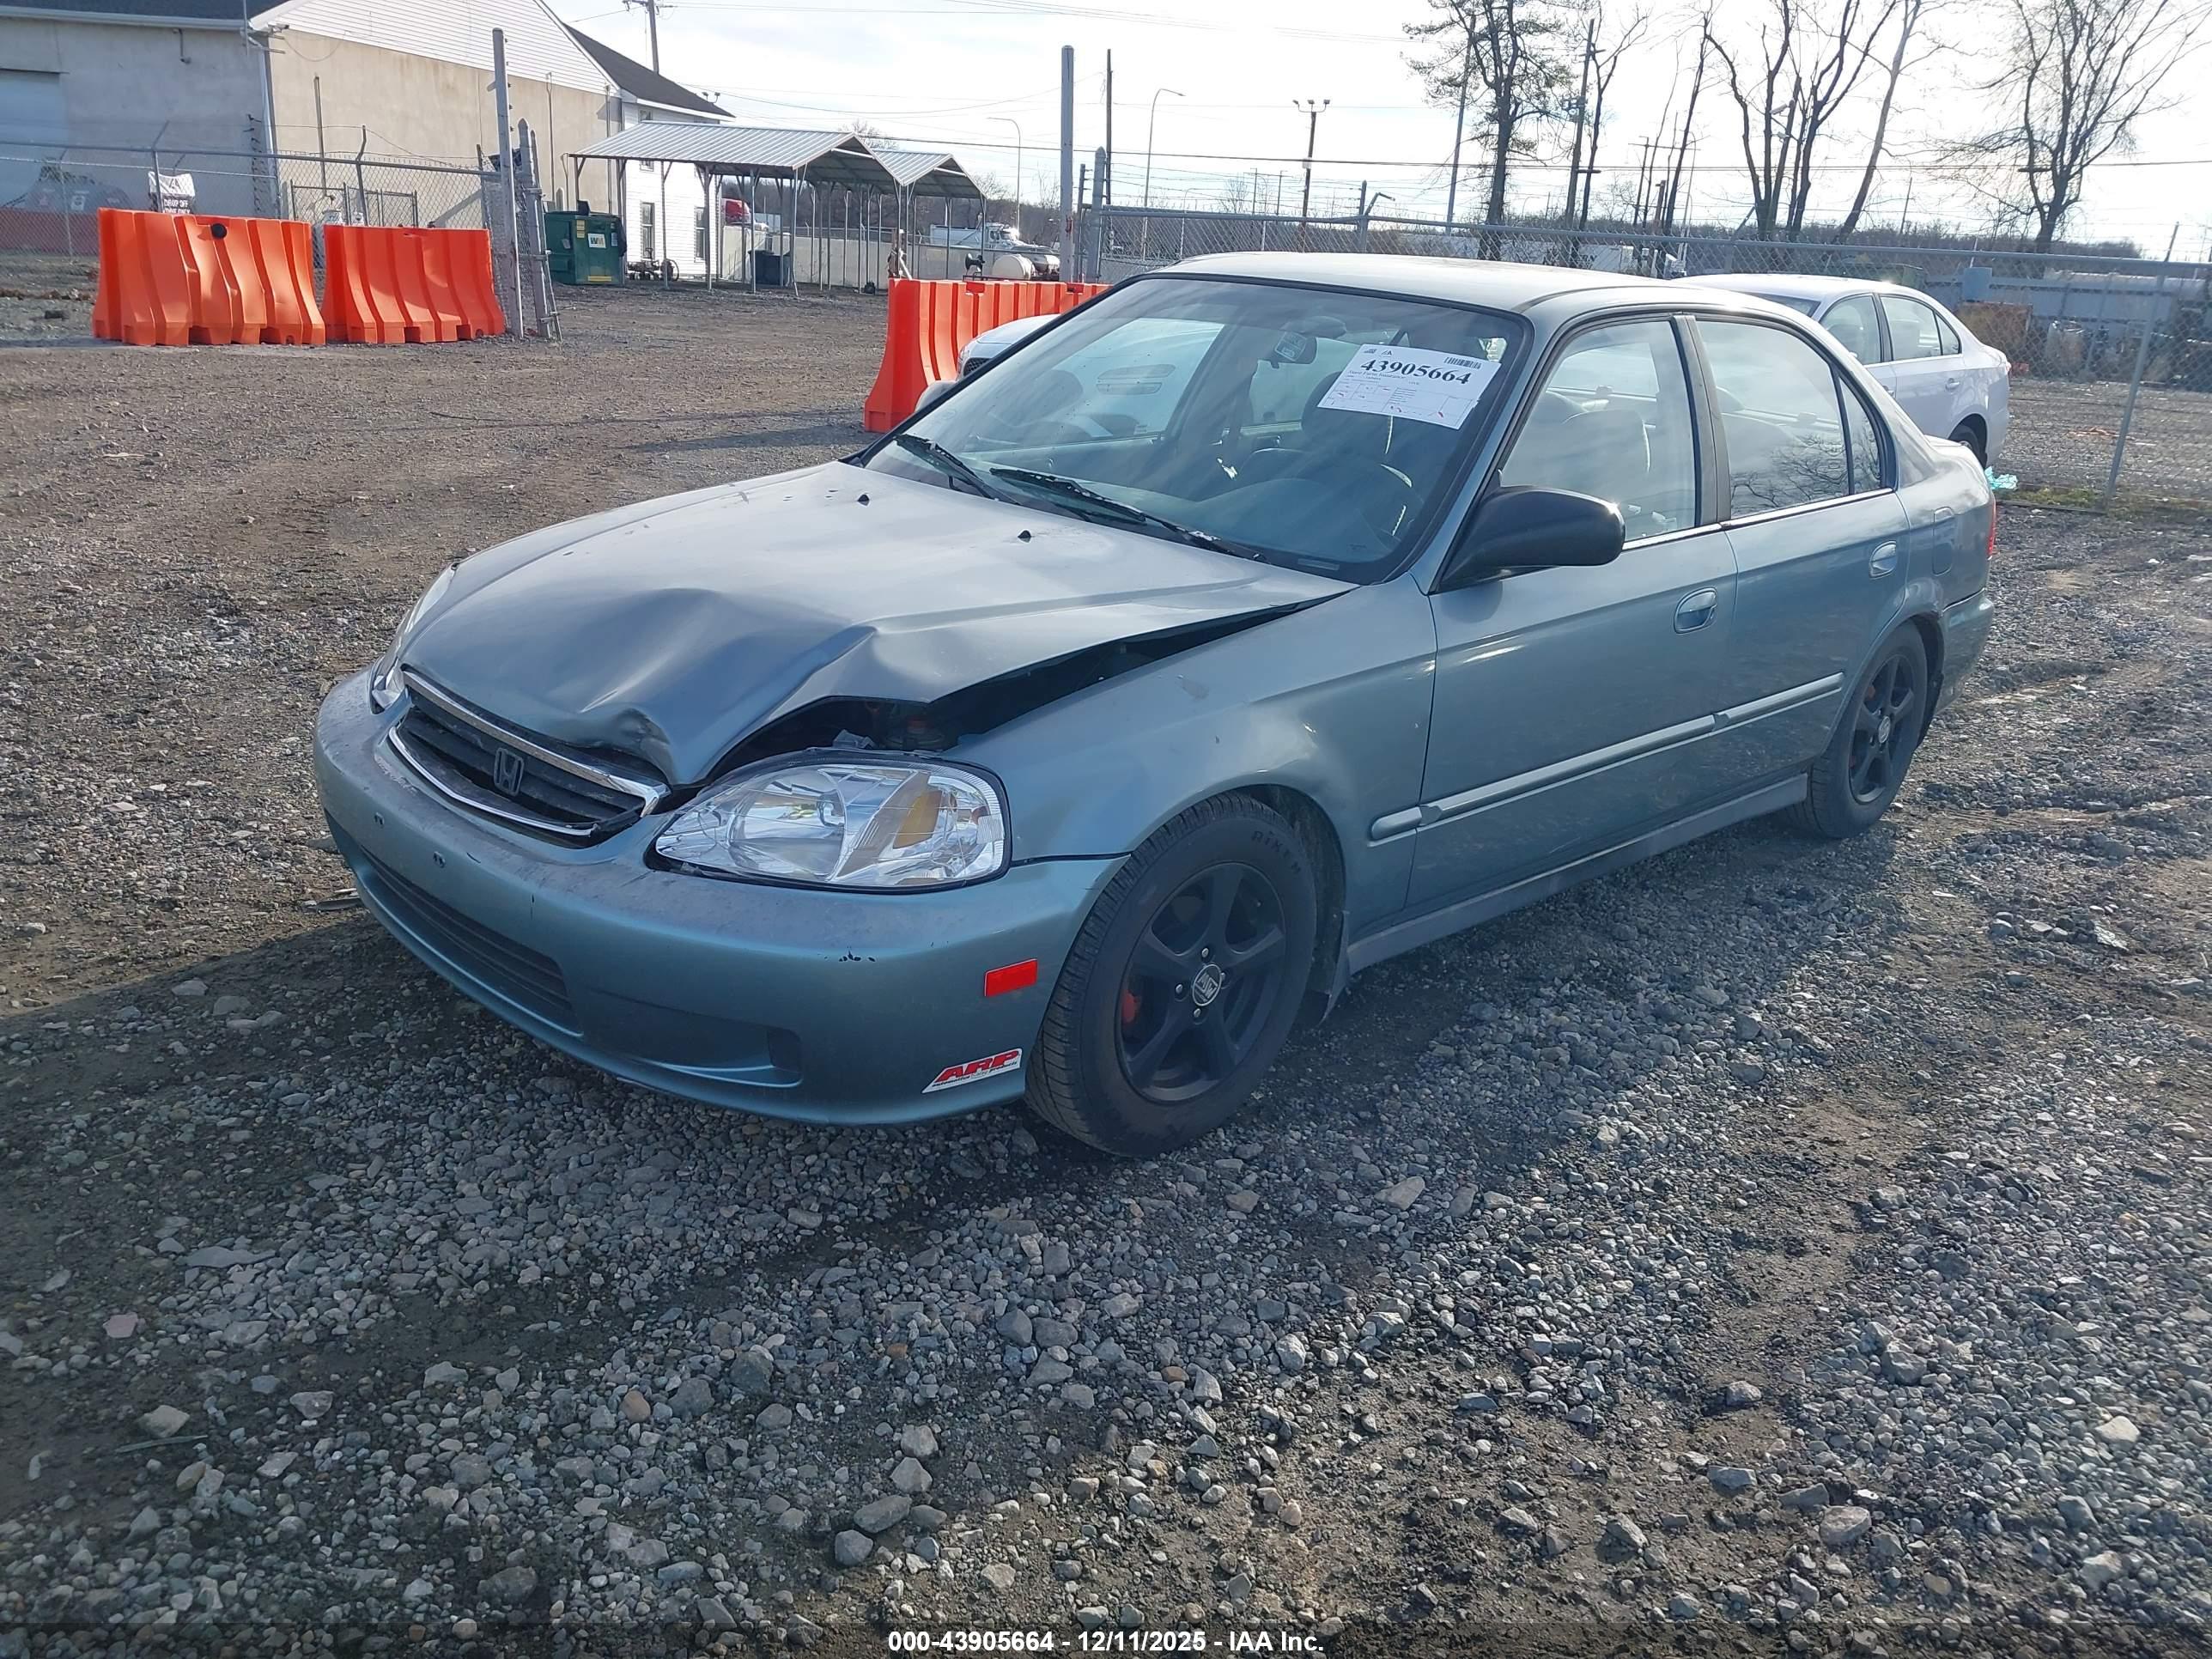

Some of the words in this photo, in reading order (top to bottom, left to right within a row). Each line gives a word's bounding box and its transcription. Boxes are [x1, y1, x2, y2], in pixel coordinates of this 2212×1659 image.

[164, 198, 179, 207] DROP
[179, 199, 189, 208] OFF
[1360, 359, 1472, 385] 43905664
[934, 1050, 1019, 1083] ARP
